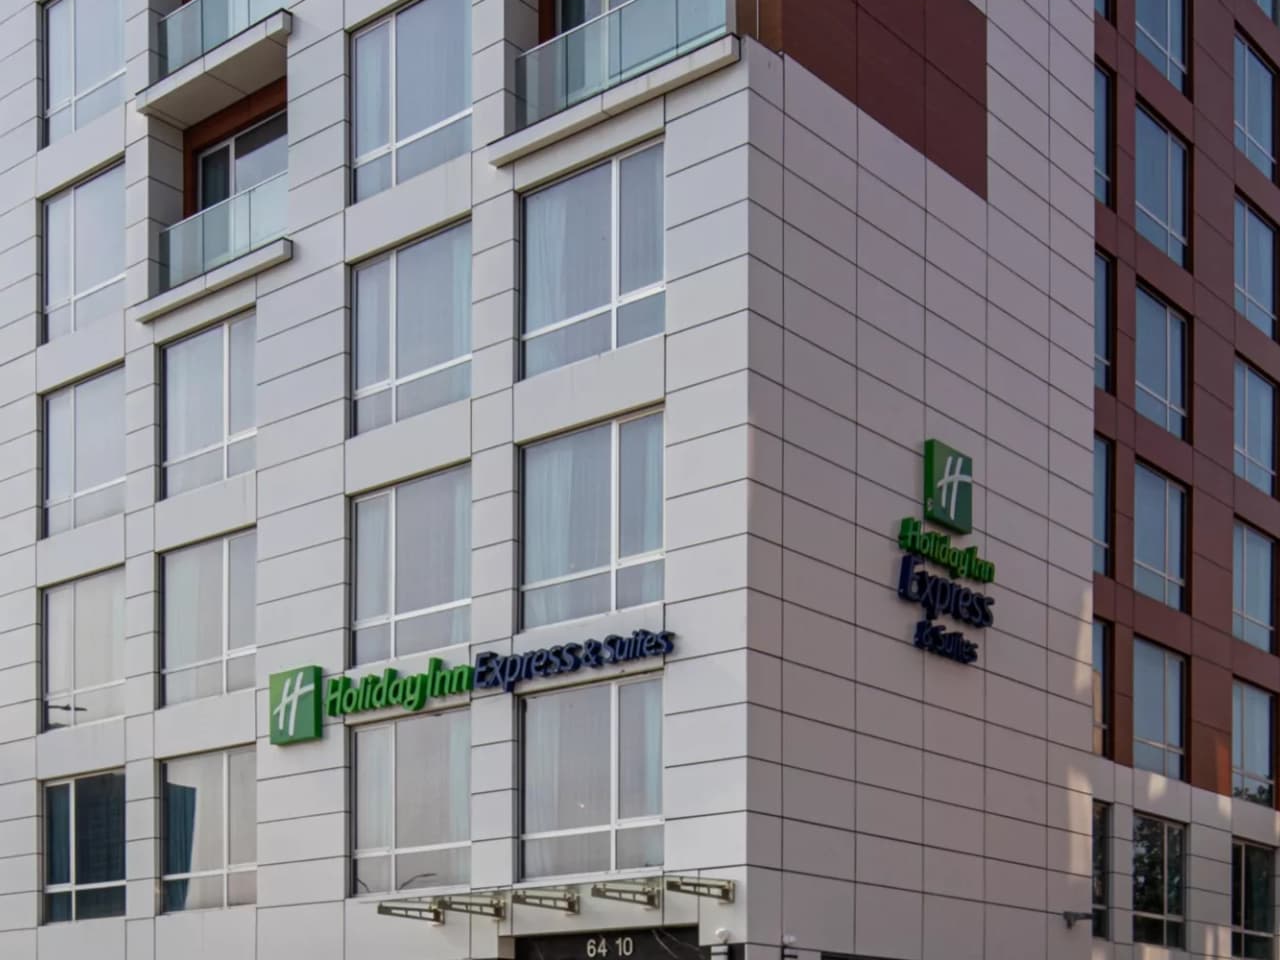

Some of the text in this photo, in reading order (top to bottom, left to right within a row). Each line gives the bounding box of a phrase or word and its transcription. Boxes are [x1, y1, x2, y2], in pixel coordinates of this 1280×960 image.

[937, 456, 972, 520] H
[899, 517, 995, 583] Holiday Inn
[898, 554, 994, 628] Express
[273, 629, 675, 736] H Holiday Inn Express & Suites
[586, 937, 634, 958] 64 10
